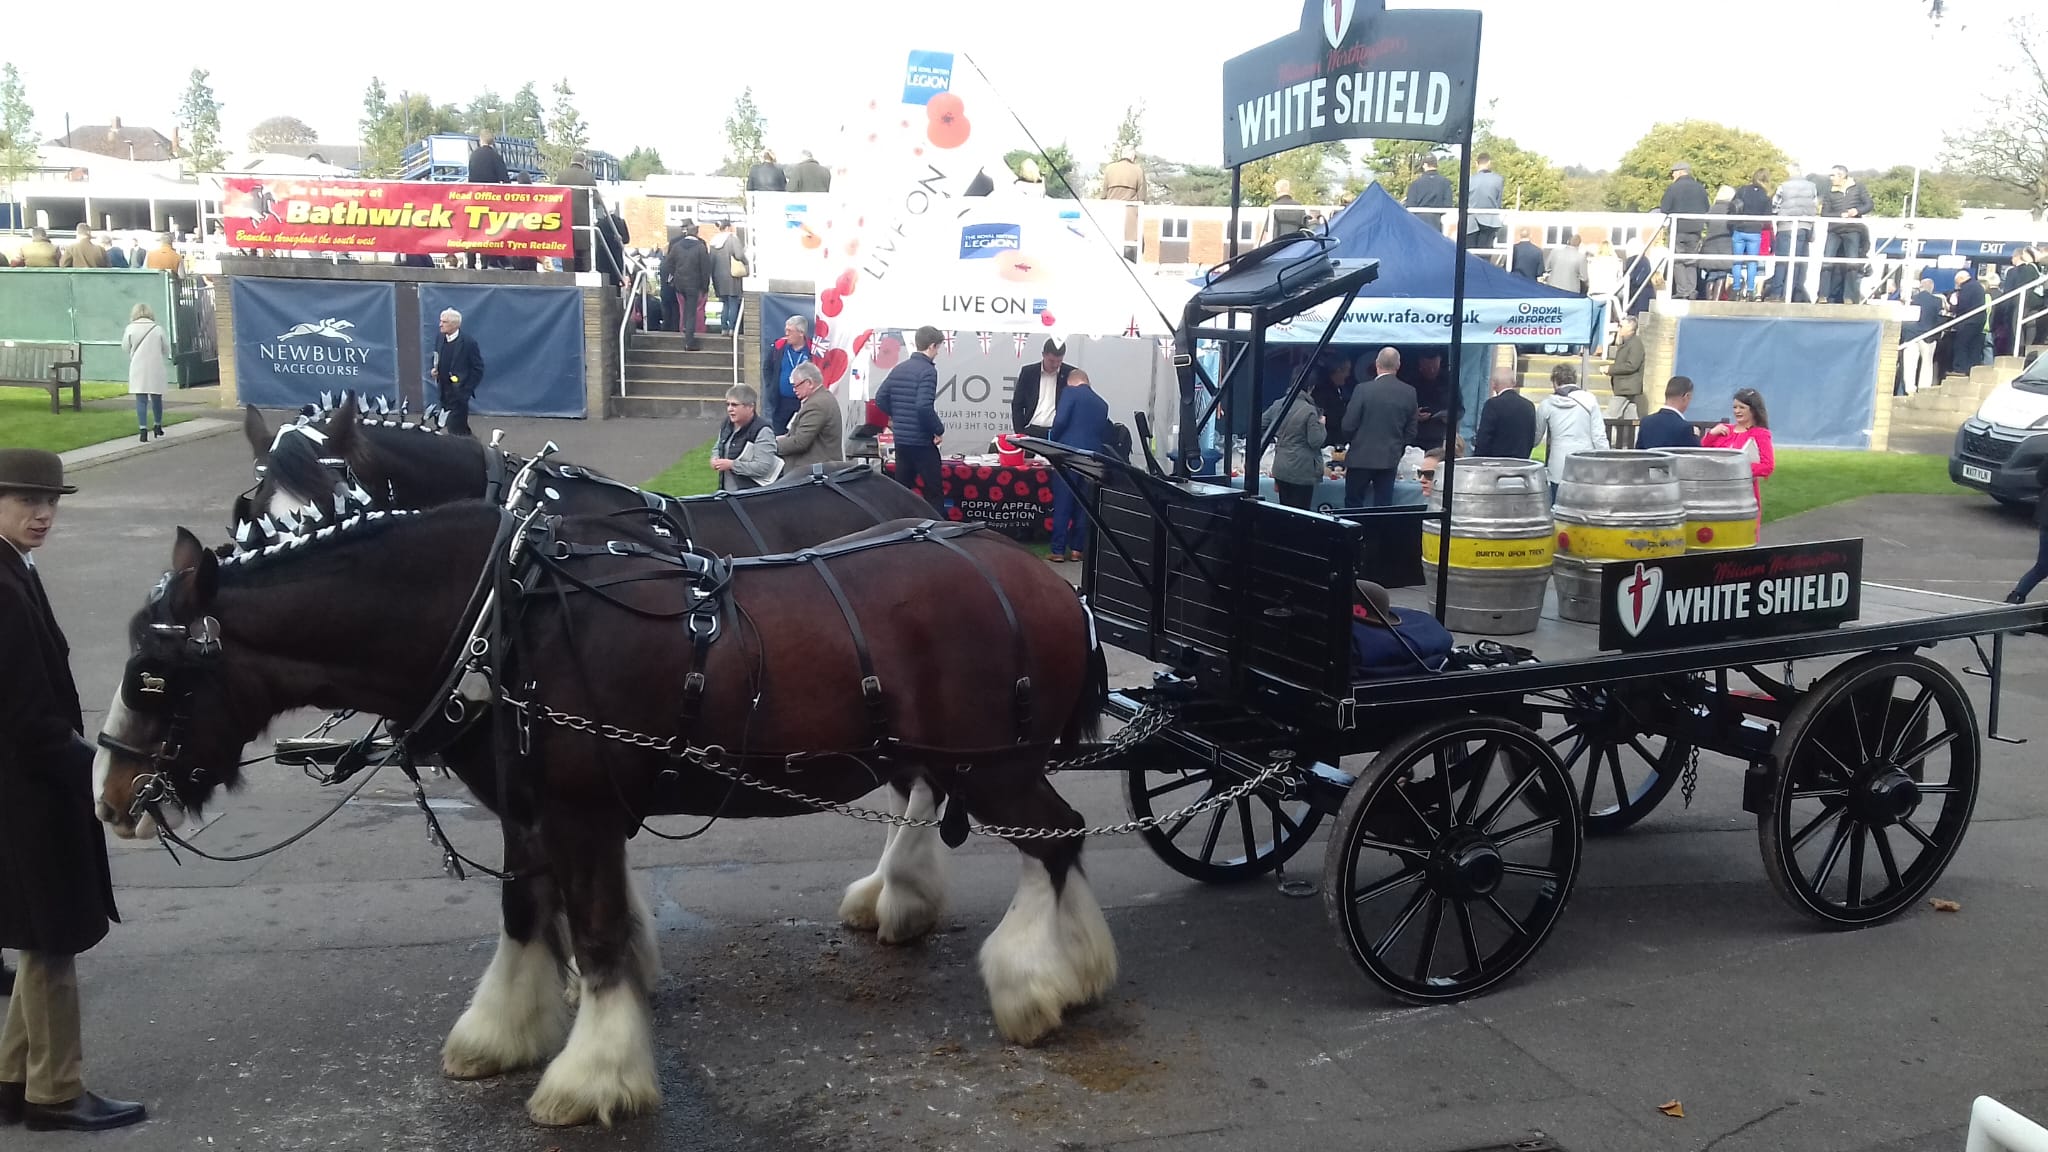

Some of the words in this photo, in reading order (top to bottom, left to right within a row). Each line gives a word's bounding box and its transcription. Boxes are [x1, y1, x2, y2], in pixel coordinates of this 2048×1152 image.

[907, 73, 949, 91] LEGION
[1238, 78, 1327, 149] WHITE
[1334, 71, 1450, 126] SHIELD
[449, 191, 472, 200] Head
[474, 192, 501, 201] Office
[286, 200, 453, 229] Bathwick
[464, 205, 561, 235] Tyres
[447, 239, 504, 250] Independent
[507, 240, 527, 250] Tyre
[530, 241, 567, 250] Retailer
[964, 239, 1018, 249] LEGION
[1980, 243, 2005, 254] EXIT
[942, 295, 985, 313] LIVE
[991, 297, 1026, 314] ON
[1532, 306, 1563, 315] ROYAL
[1507, 315, 1525, 324] AIR
[1525, 315, 1562, 324] FORCES
[1494, 325, 1562, 336] Association
[260, 344, 370, 364] NEWBURY
[273, 363, 359, 376] RACECOURSE
[961, 501, 997, 510] POPPY
[1002, 502, 1044, 513] APPEAL
[966, 510, 1035, 520] COLLECTION
[1666, 582, 1750, 626] WHITE
[1758, 571, 1849, 615] SHIELD
